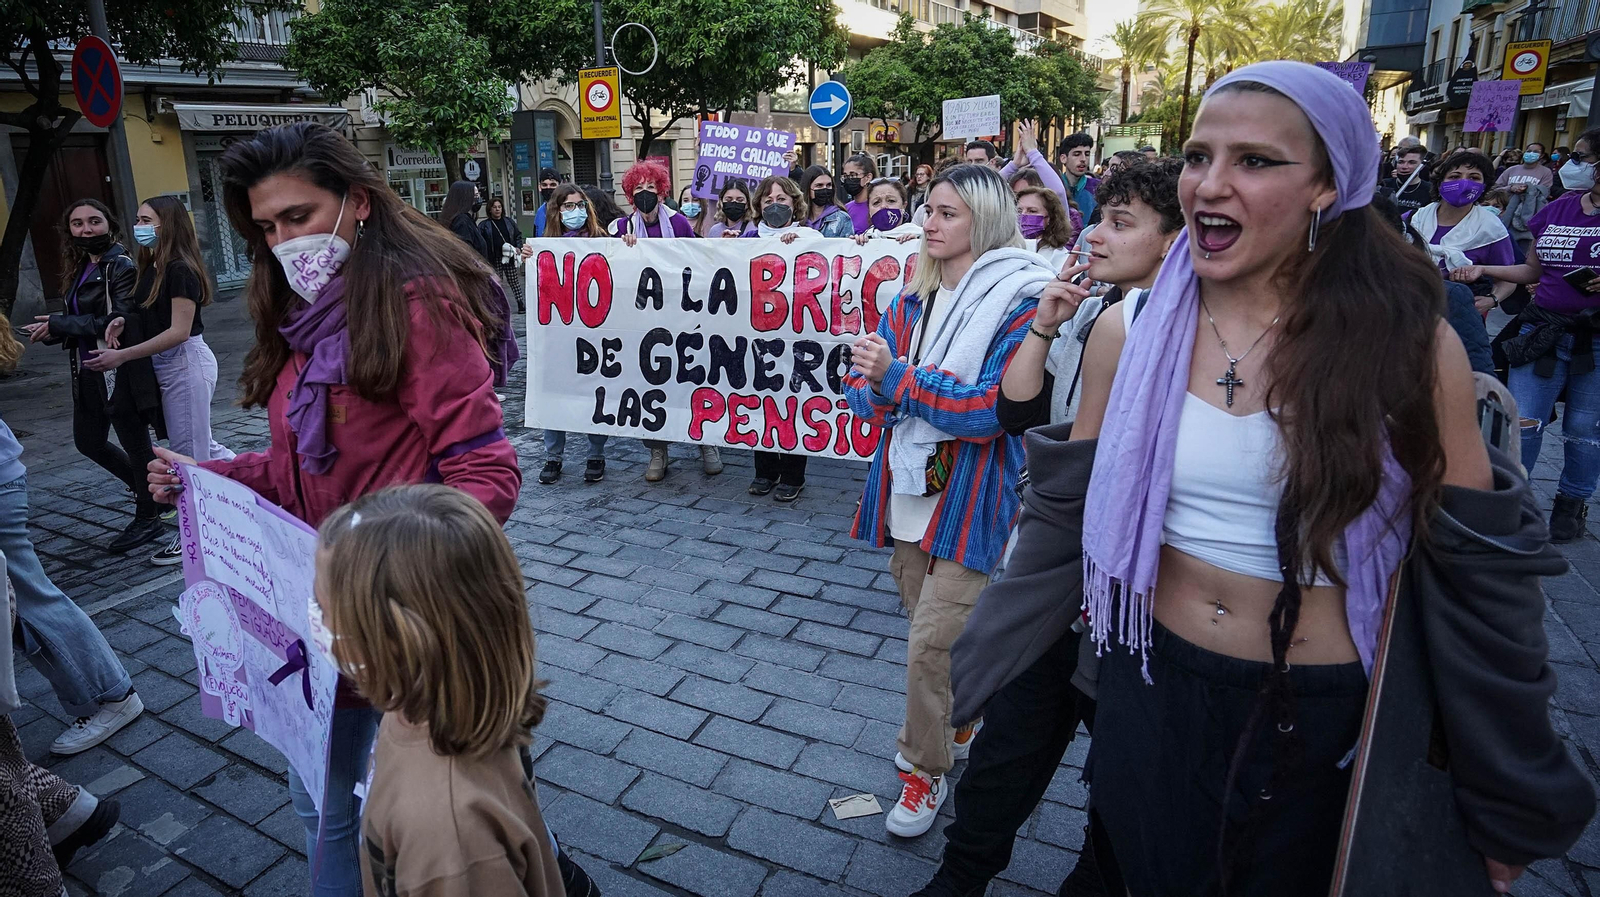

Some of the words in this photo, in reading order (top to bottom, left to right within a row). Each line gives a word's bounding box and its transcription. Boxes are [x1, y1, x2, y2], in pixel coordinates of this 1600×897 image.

[584, 70, 612, 78] RECUERDE
[705, 124, 739, 140] TODO
[745, 130, 761, 143] LO
[767, 132, 789, 148] QUE
[396, 154, 442, 166] Corredera
[700, 143, 736, 159] HEMOS
[741, 147, 789, 168] CALLADO
[714, 161, 743, 174] AHORA
[747, 164, 773, 178] GRITA
[1537, 238, 1577, 248] COMO
[1545, 226, 1600, 236] SORORI
[296, 268, 319, 292] LAS
[317, 246, 338, 268] QUE
[537, 250, 614, 328] NO
[635, 267, 664, 311] A
[681, 266, 738, 316] LA
[577, 337, 623, 378] DE
[639, 324, 853, 396] GÉNERO
[592, 386, 667, 432] LAS
[180, 486, 192, 538] ARZO
